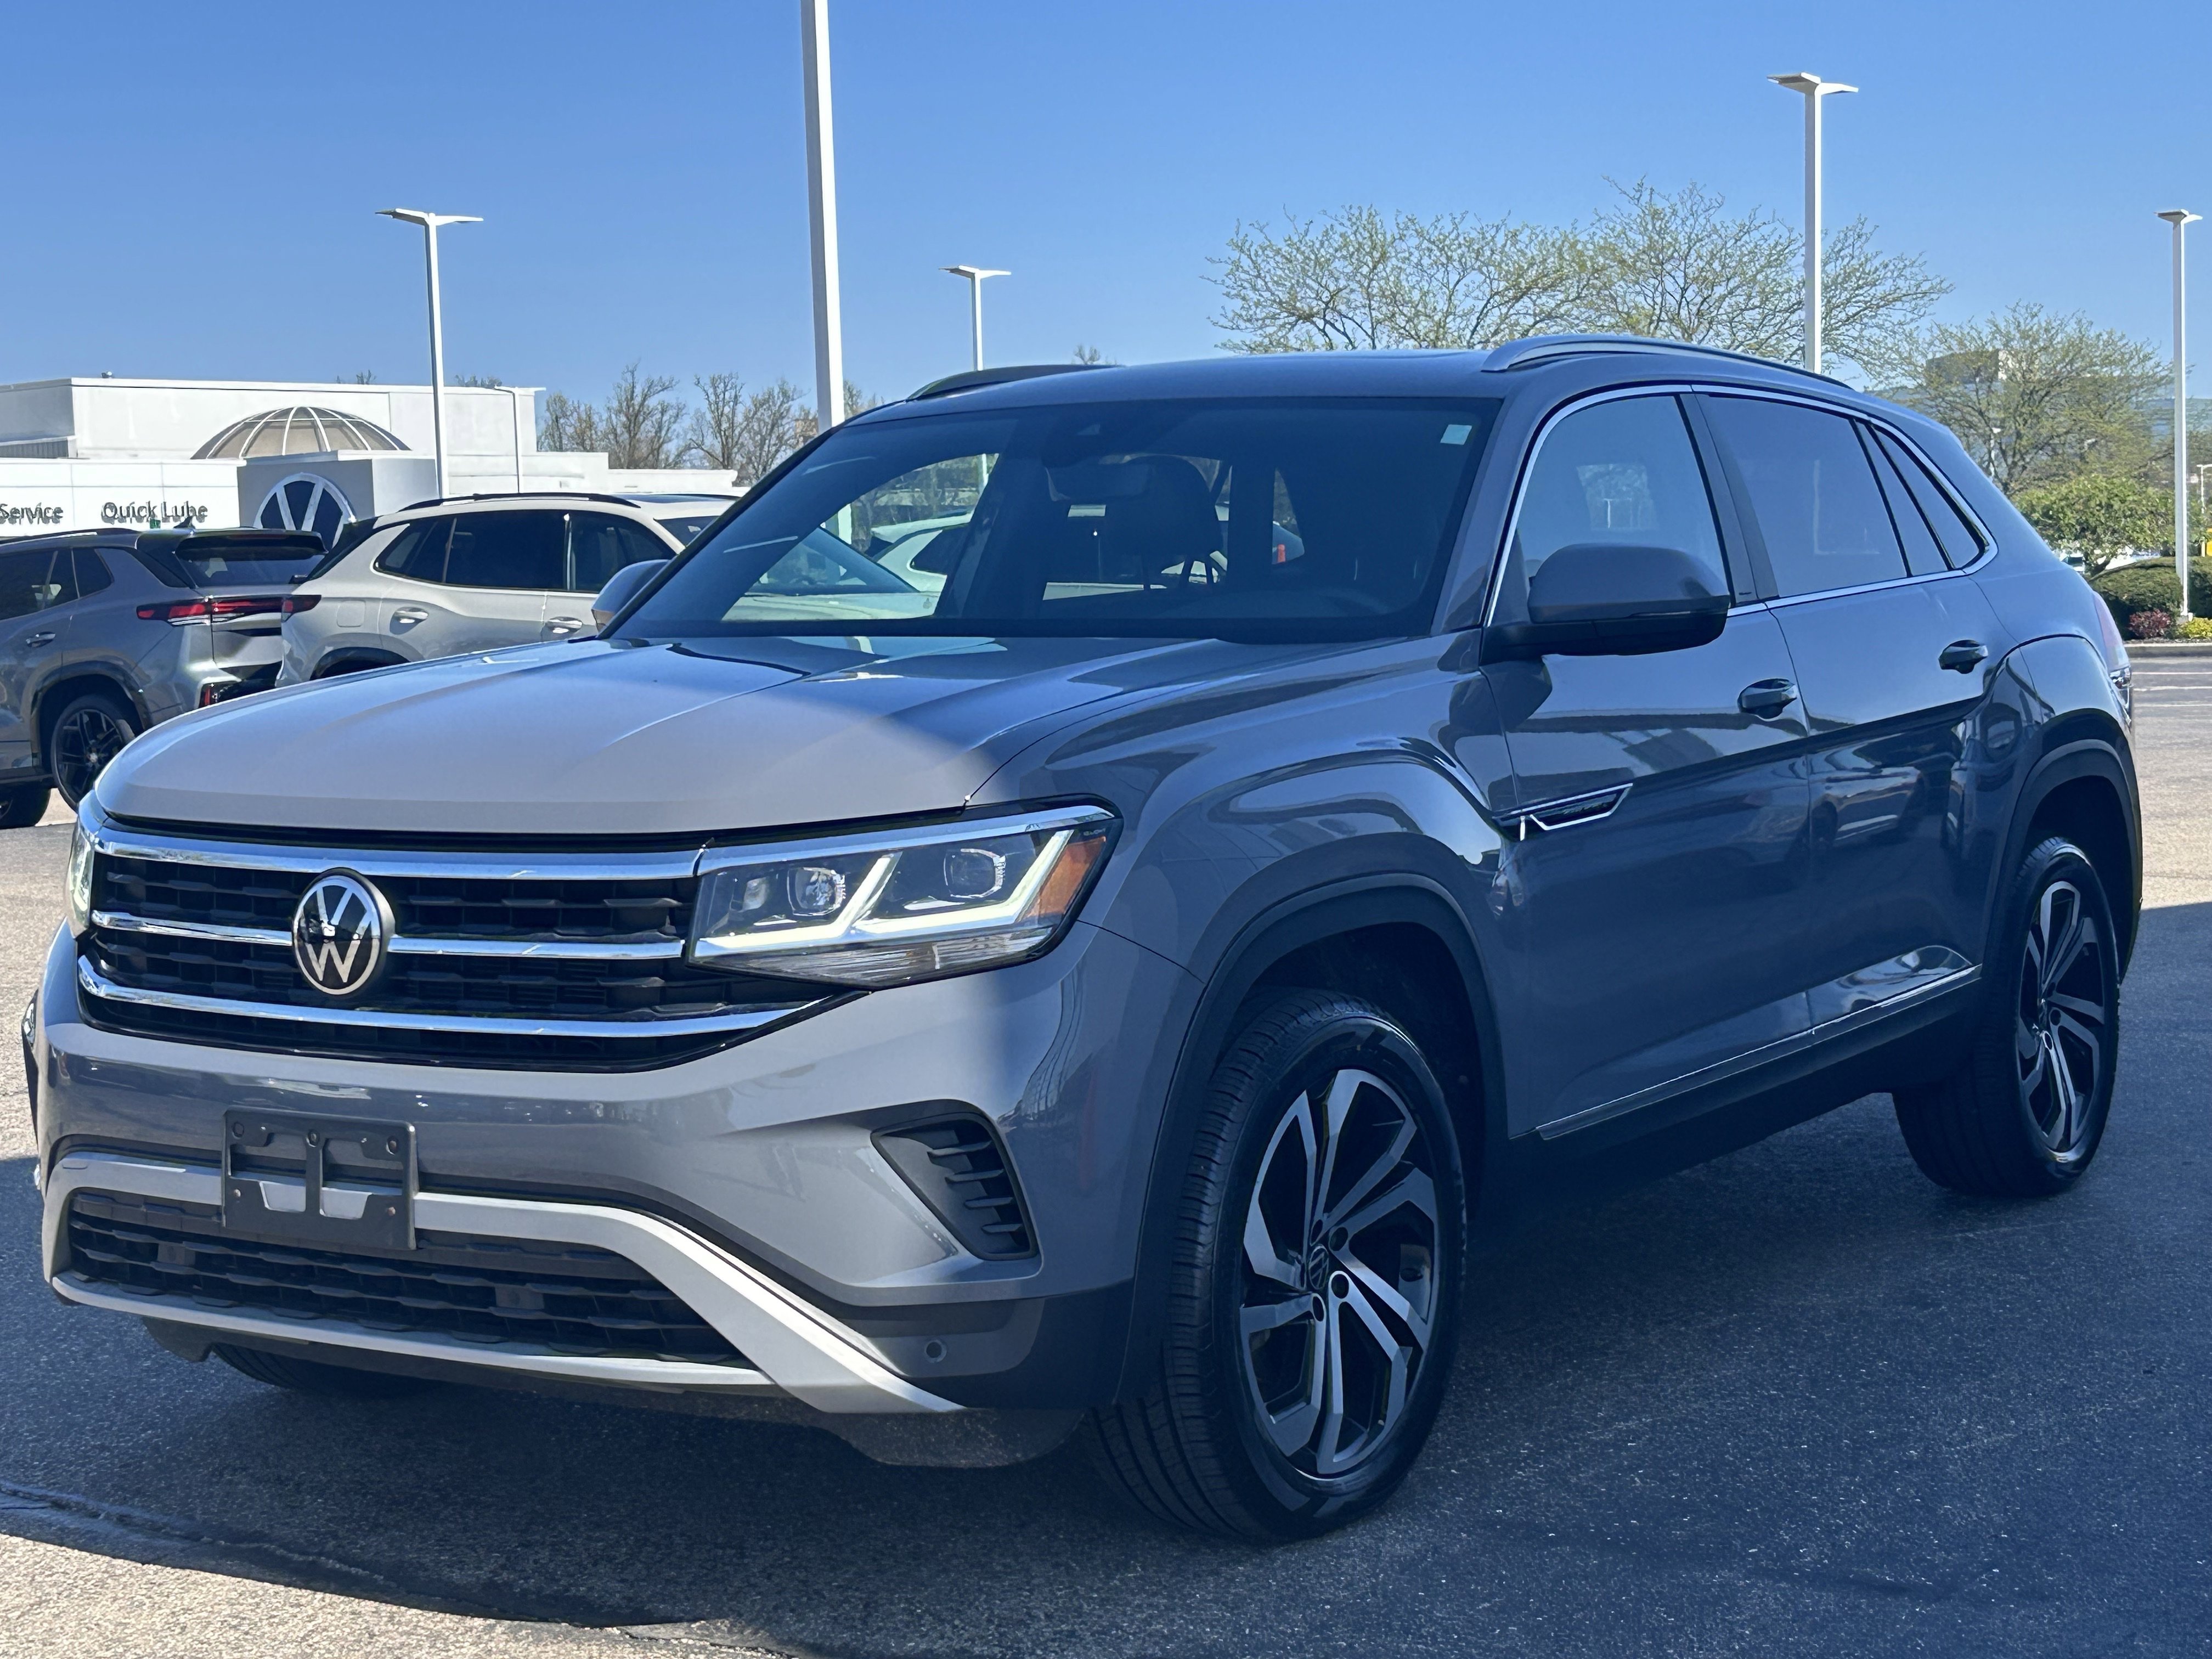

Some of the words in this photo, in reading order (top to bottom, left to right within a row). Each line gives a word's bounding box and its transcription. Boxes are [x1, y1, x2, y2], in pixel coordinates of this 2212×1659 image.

[0, 503, 64, 522] Service
[101, 501, 157, 523] Quick
[161, 500, 208, 521] Lube
[293, 875, 381, 995] VW
